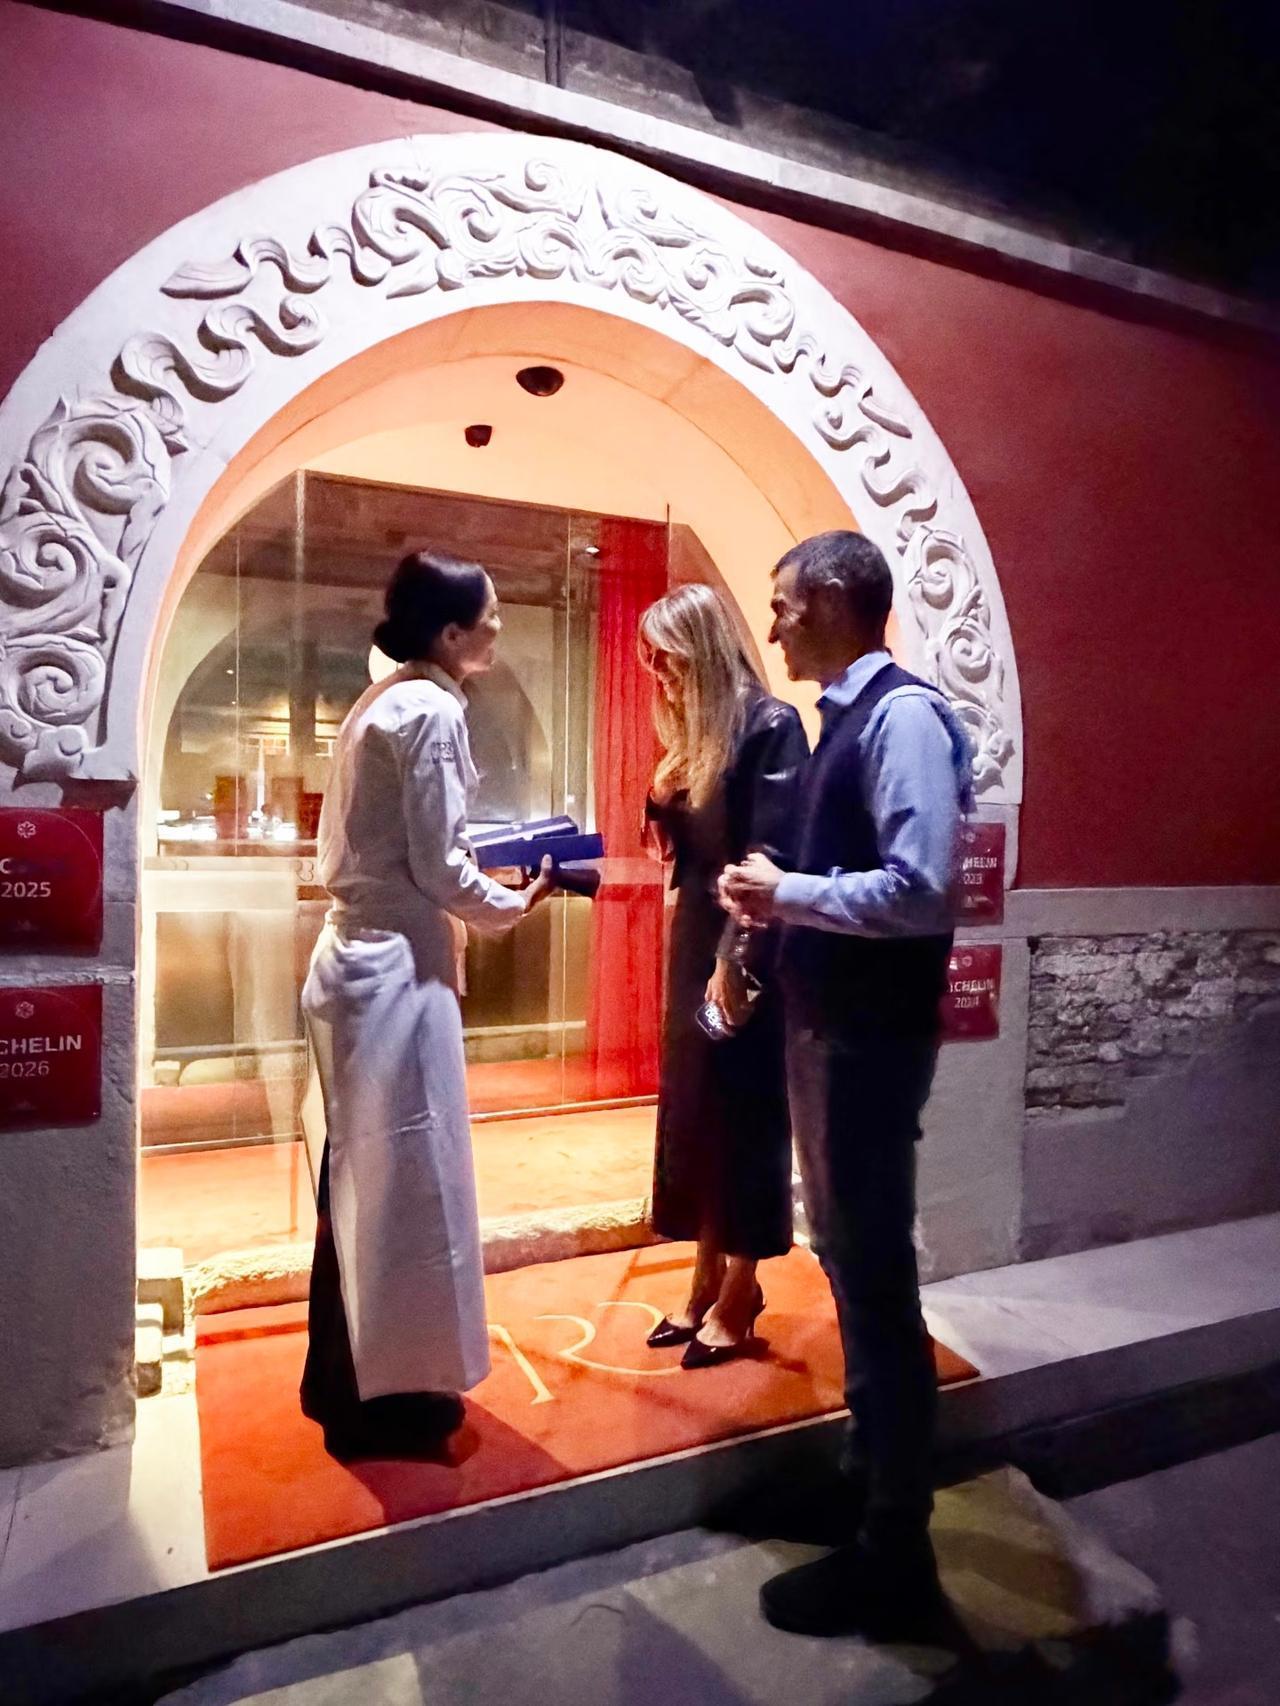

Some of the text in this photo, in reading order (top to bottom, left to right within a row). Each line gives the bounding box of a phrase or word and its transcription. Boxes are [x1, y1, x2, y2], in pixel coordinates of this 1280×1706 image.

[0, 881, 51, 898] 2025
[949, 979, 994, 992] ICHELIN
[0, 1034, 82, 1055] CHELIN
[0, 1060, 50, 1078] 2026
